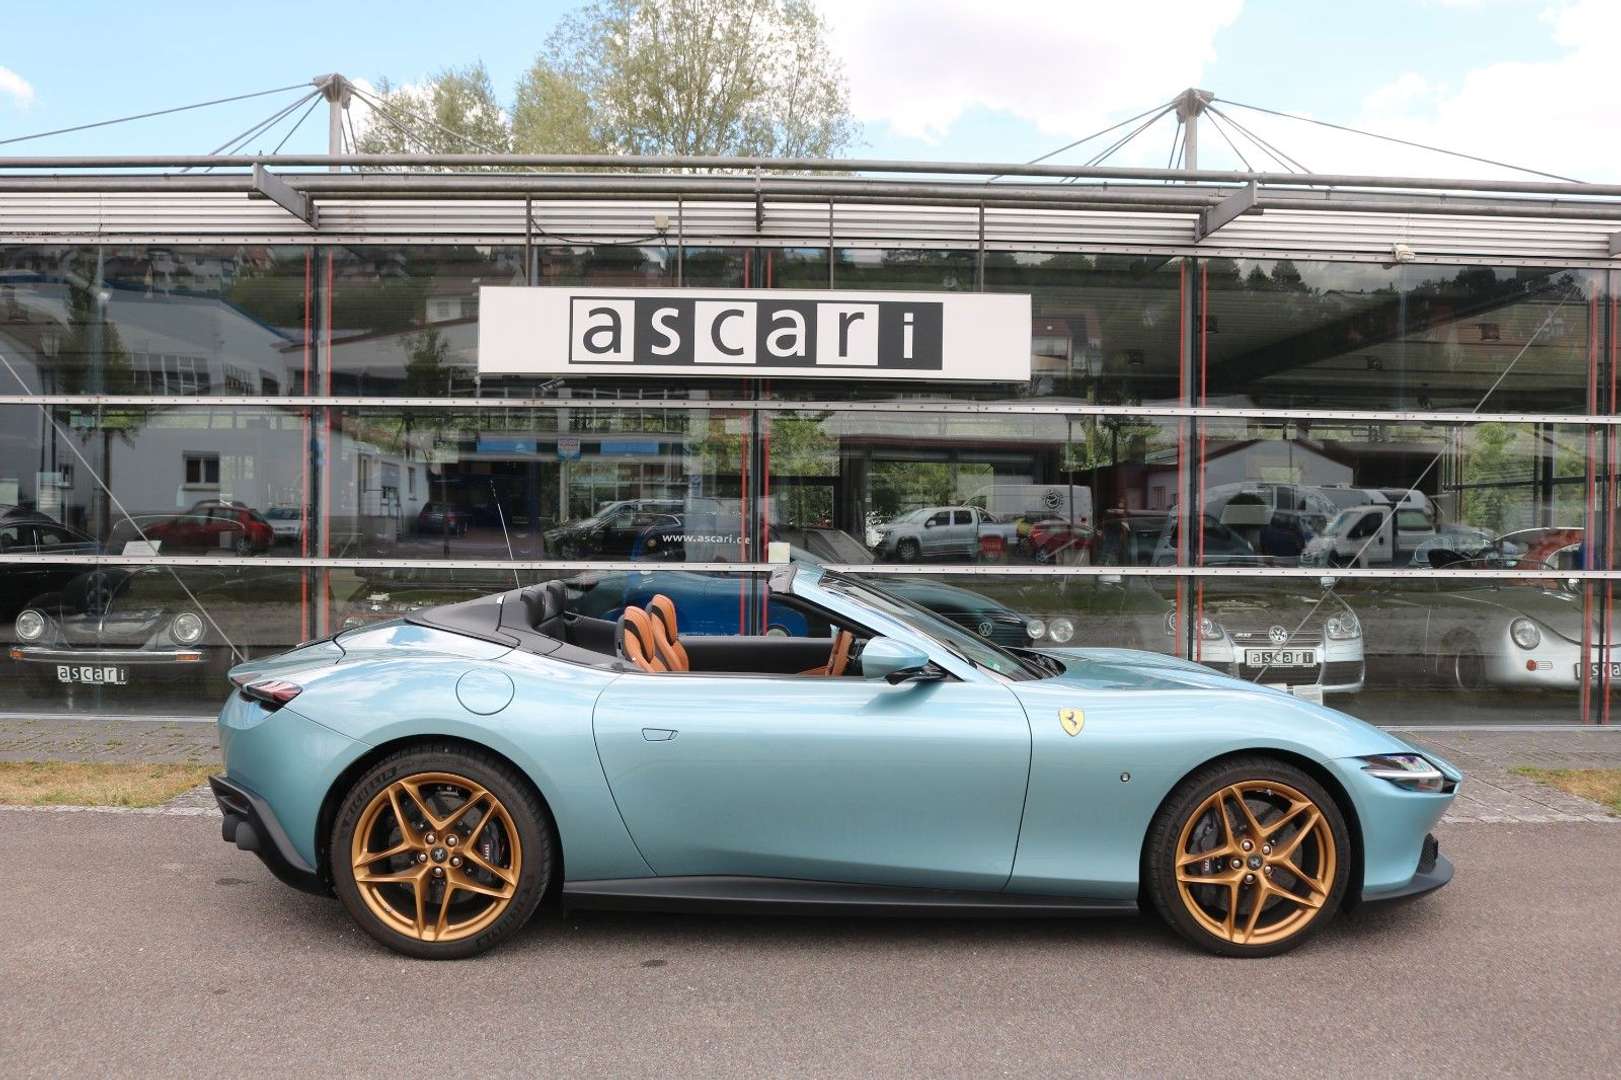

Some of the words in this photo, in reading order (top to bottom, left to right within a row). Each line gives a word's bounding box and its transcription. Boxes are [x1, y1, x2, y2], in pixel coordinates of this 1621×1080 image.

[581, 305, 915, 360] ascari
[1252, 651, 1311, 664] ascari
[59, 667, 125, 682] ascari
